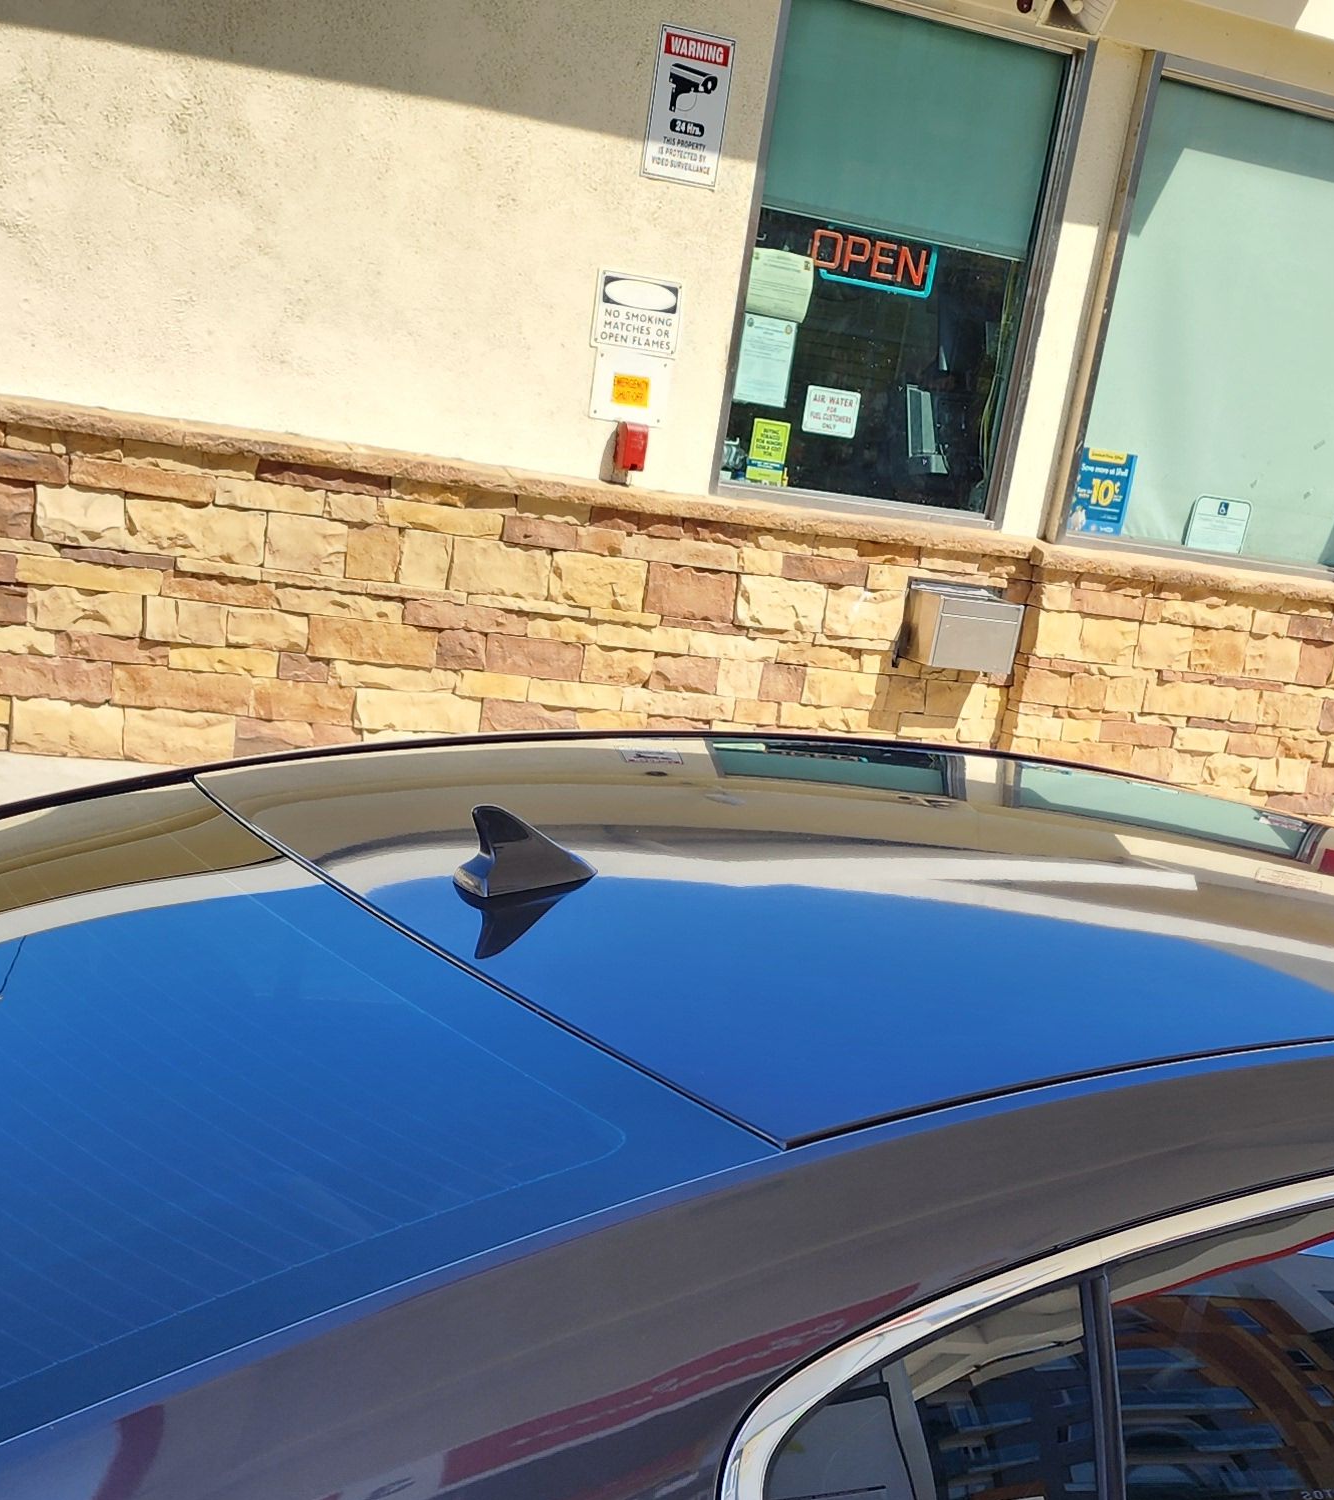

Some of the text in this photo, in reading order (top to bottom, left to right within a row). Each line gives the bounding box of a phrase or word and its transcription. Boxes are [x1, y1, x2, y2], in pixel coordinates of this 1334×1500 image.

[671, 35, 724, 63] WARNING
[675, 120, 686, 132] 24
[663, 136, 706, 152] THIS PROPERTY
[665, 147, 698, 161] PROTECTED
[651, 155, 711, 175] VIDEO SURVEILLANCE
[810, 229, 927, 286] OPEN
[605, 309, 672, 327] NO SMOKING
[603, 321, 669, 338] MATCHES OR
[600, 331, 671, 350] OPEN FLAMES
[813, 393, 854, 407] AIR WATER
